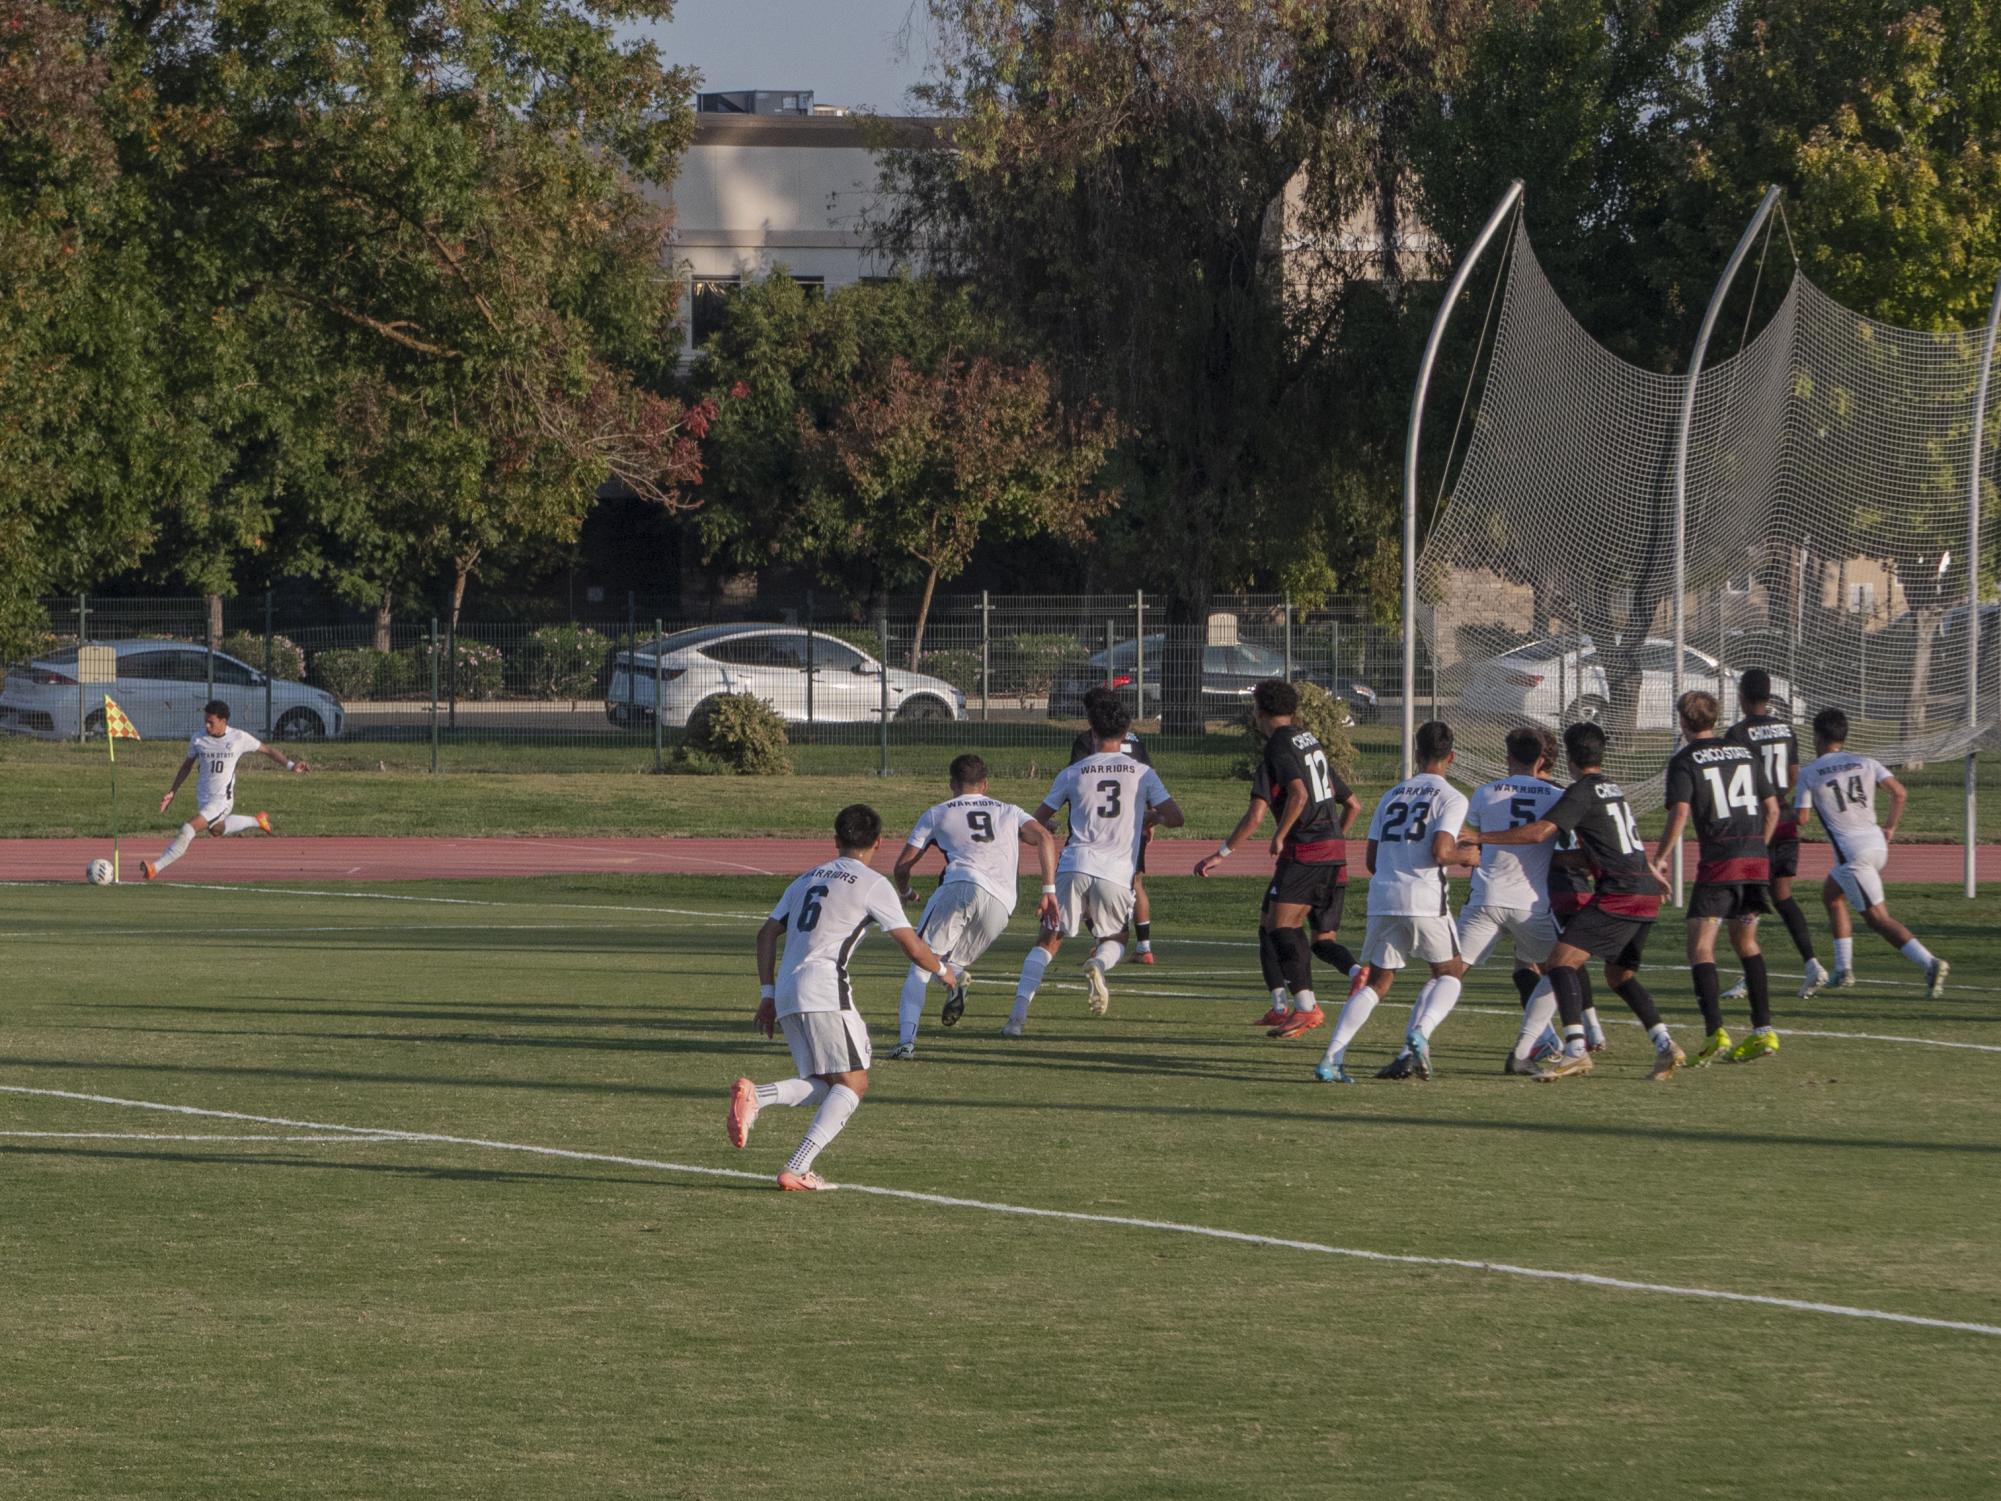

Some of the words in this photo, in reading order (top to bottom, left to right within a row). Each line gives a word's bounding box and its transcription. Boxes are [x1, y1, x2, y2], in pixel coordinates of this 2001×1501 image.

[210, 760, 224, 774] 10
[1081, 764, 1136, 775] WARRIORS
[1692, 748, 1724, 764] CHICO
[1722, 746, 1753, 760] STATE
[1761, 743, 1788, 788] 11
[1304, 750, 1332, 803] 12
[1494, 783, 1551, 796] WARRIORS
[1702, 764, 1758, 819] 14
[1826, 775, 1868, 813] 14
[1097, 779, 1121, 818] 3
[1510, 797, 1537, 829] 5
[966, 810, 996, 843] 9
[1380, 801, 1431, 842] 23
[797, 885, 830, 933] 6
